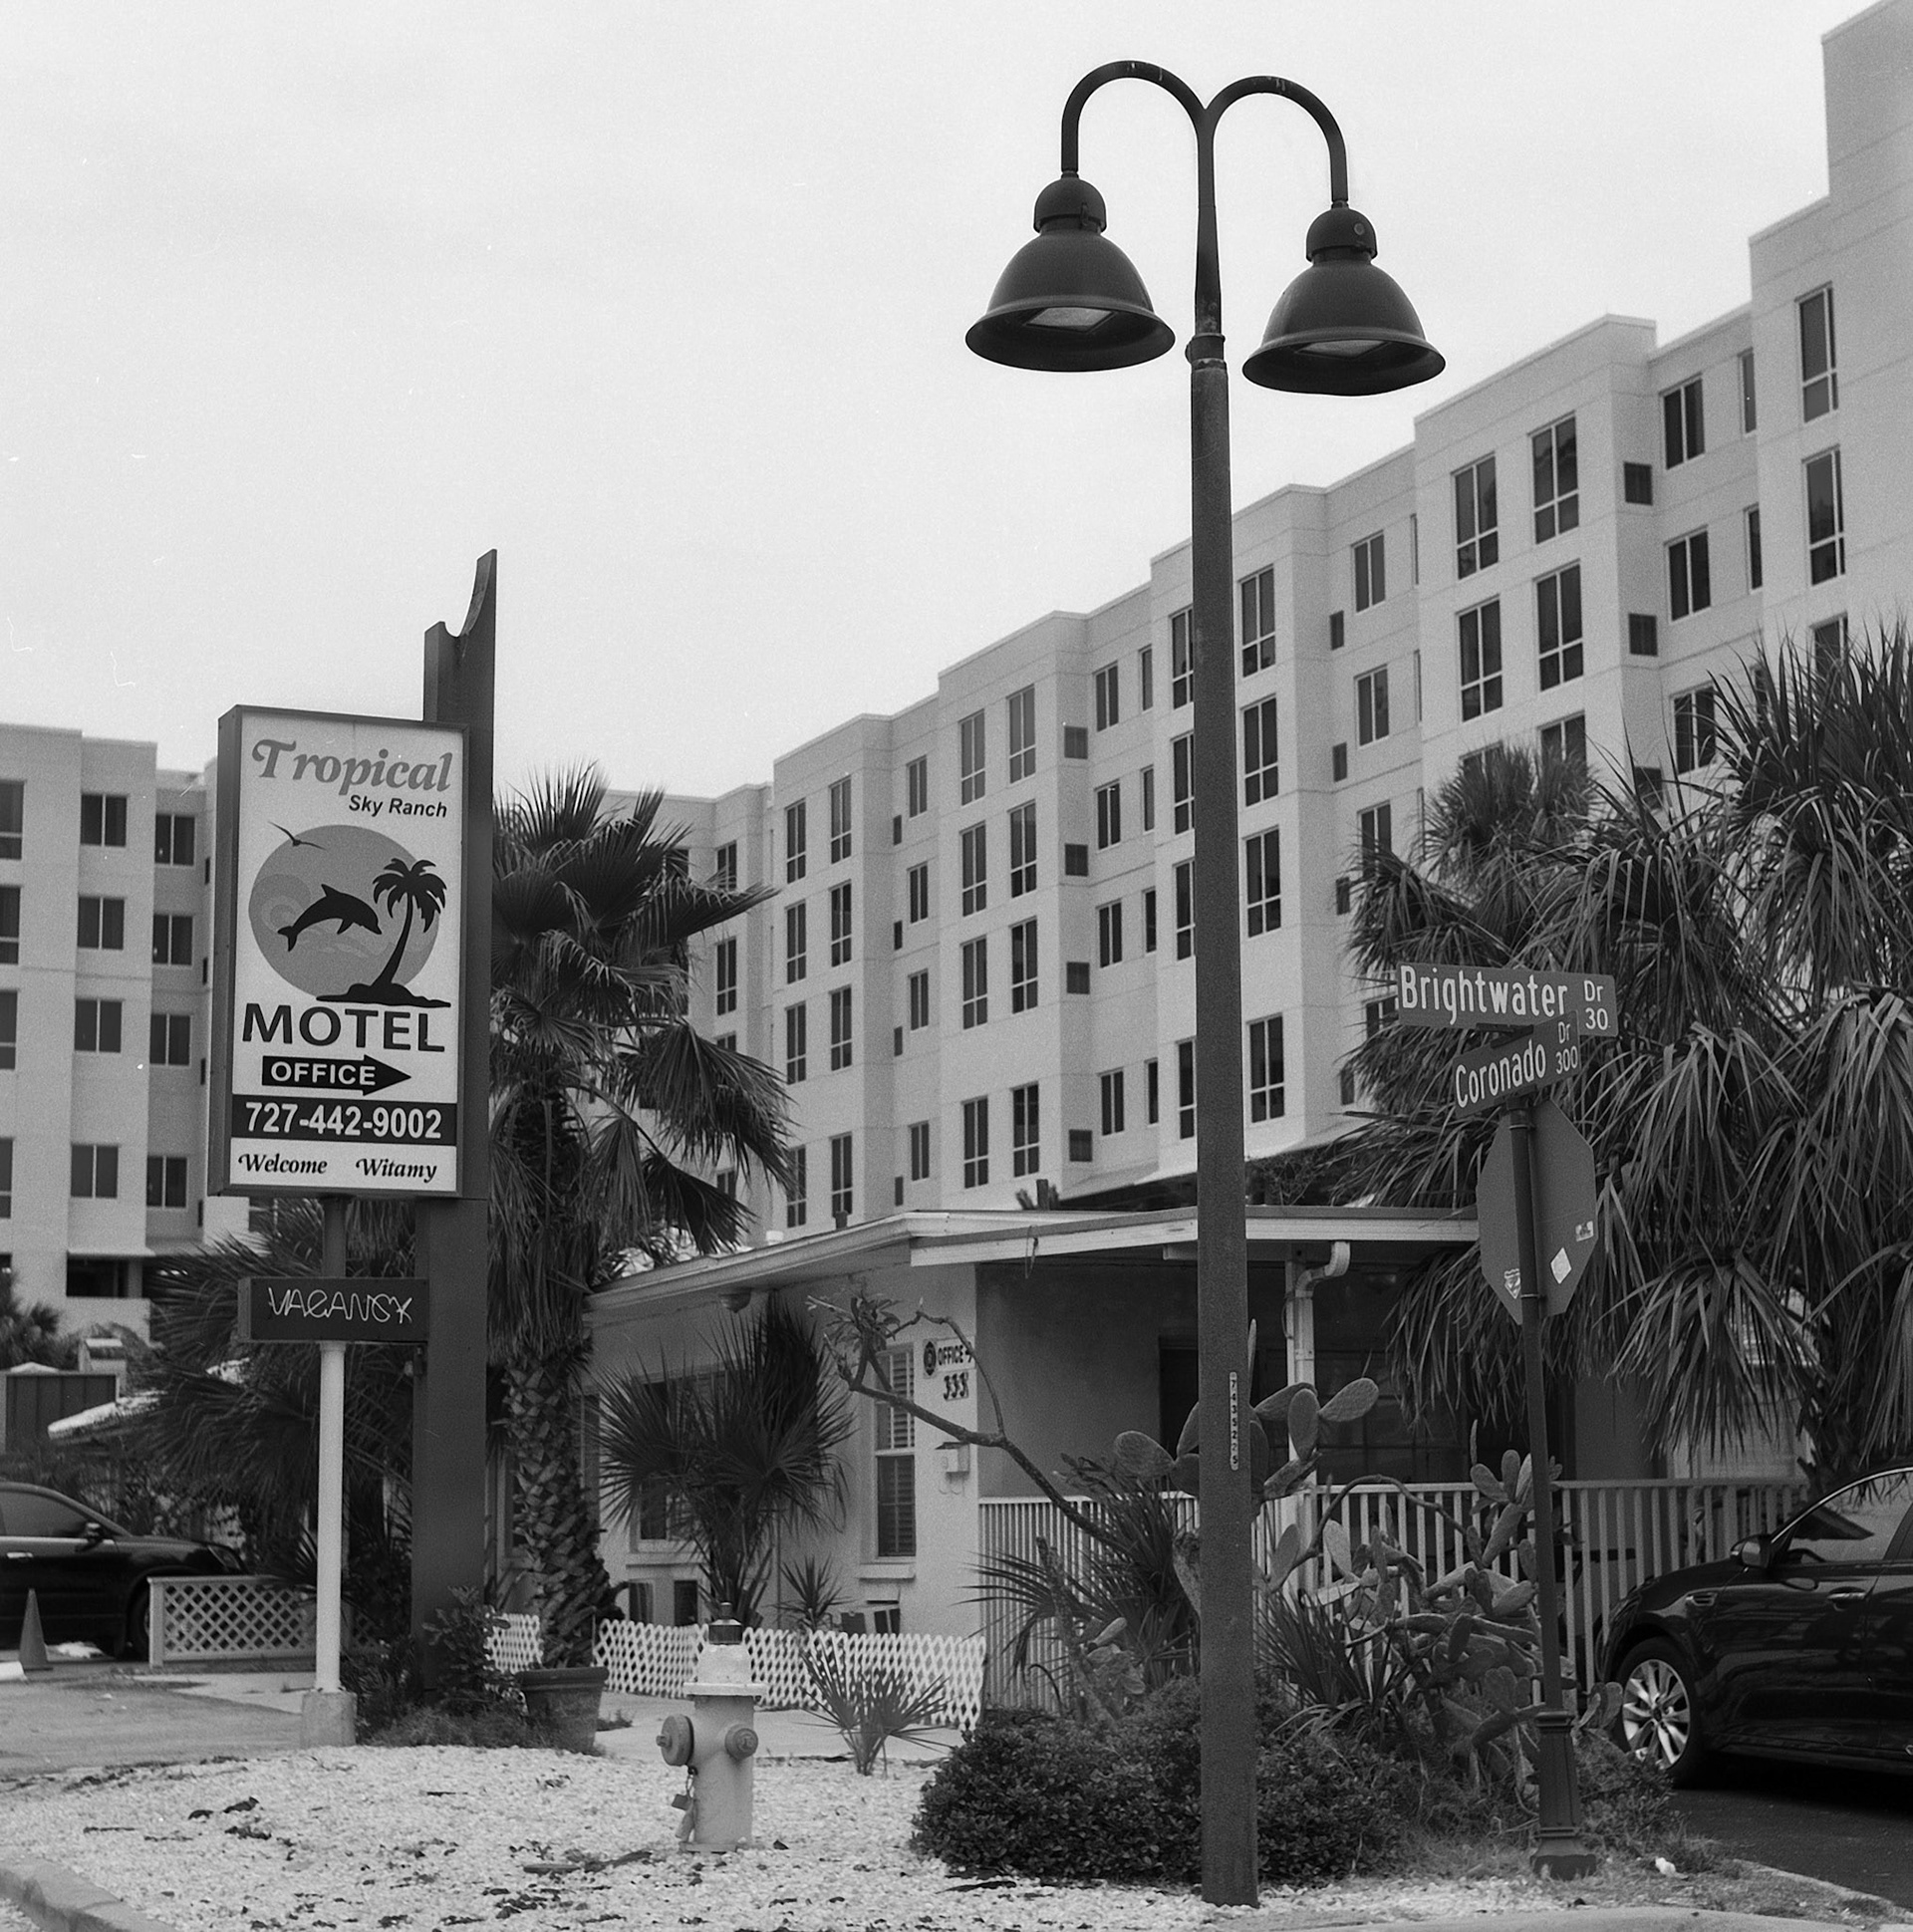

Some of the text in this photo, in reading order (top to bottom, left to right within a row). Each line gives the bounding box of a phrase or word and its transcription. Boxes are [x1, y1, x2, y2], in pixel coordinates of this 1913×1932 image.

[252, 738, 453, 795] Tropical
[349, 795, 447, 817] Sky Ranch
[1401, 966, 1604, 1025] Brightwater Dr
[242, 1002, 445, 1052] MOTEL
[1585, 1007, 1609, 1030] 30
[271, 1061, 376, 1085] OFFICE
[1456, 1021, 1571, 1108] Coronado Dr
[1555, 1046, 1578, 1074] 300
[246, 1102, 441, 1139] 727-442-9002
[238, 1154, 437, 1183] Welcome Witamy
[268, 1287, 411, 1324] VACANCY
[938, 1345, 963, 1366] OFFICE
